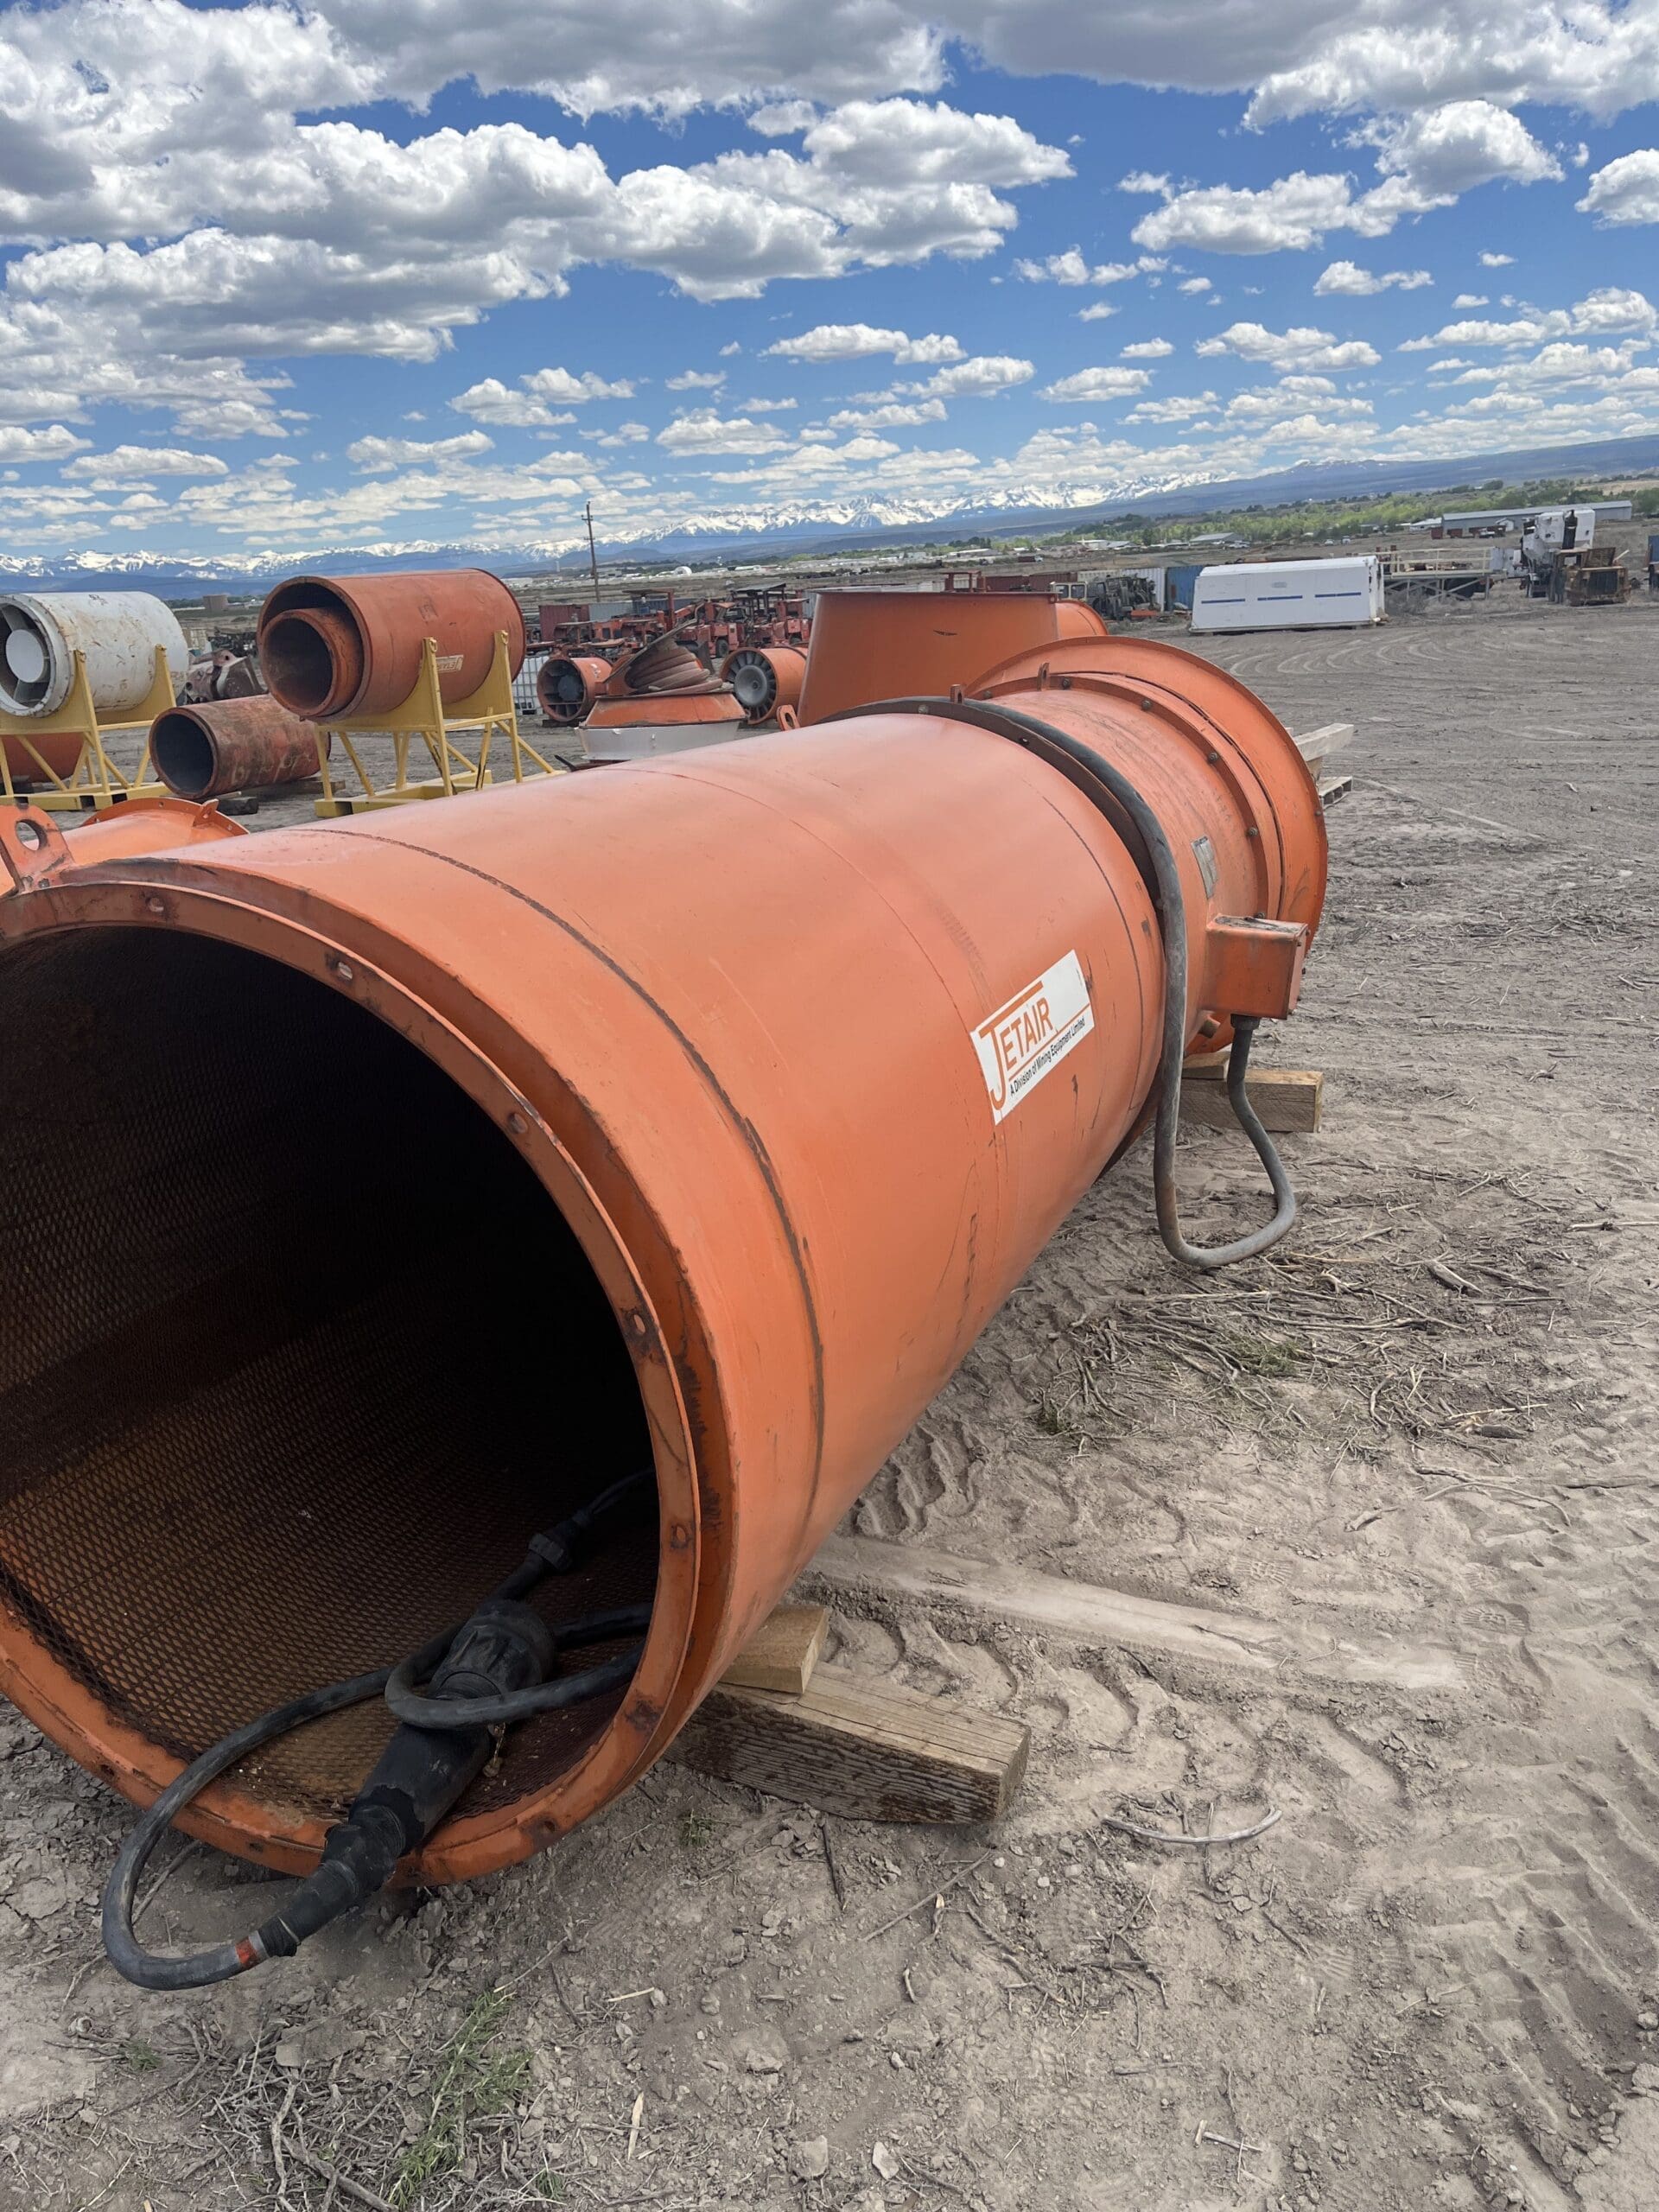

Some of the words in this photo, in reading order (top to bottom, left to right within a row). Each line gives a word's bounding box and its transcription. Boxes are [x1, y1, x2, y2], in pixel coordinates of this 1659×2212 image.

[978, 980, 1053, 1110] JETAIR
[1010, 1084, 1015, 1096] A
[1014, 1069, 1032, 1091] Division
[1032, 1062, 1037, 1074] of
[1035, 1050, 1052, 1070] Mining
[1050, 1028, 1072, 1056] Equipment
[1071, 1017, 1084, 1037] Limited
